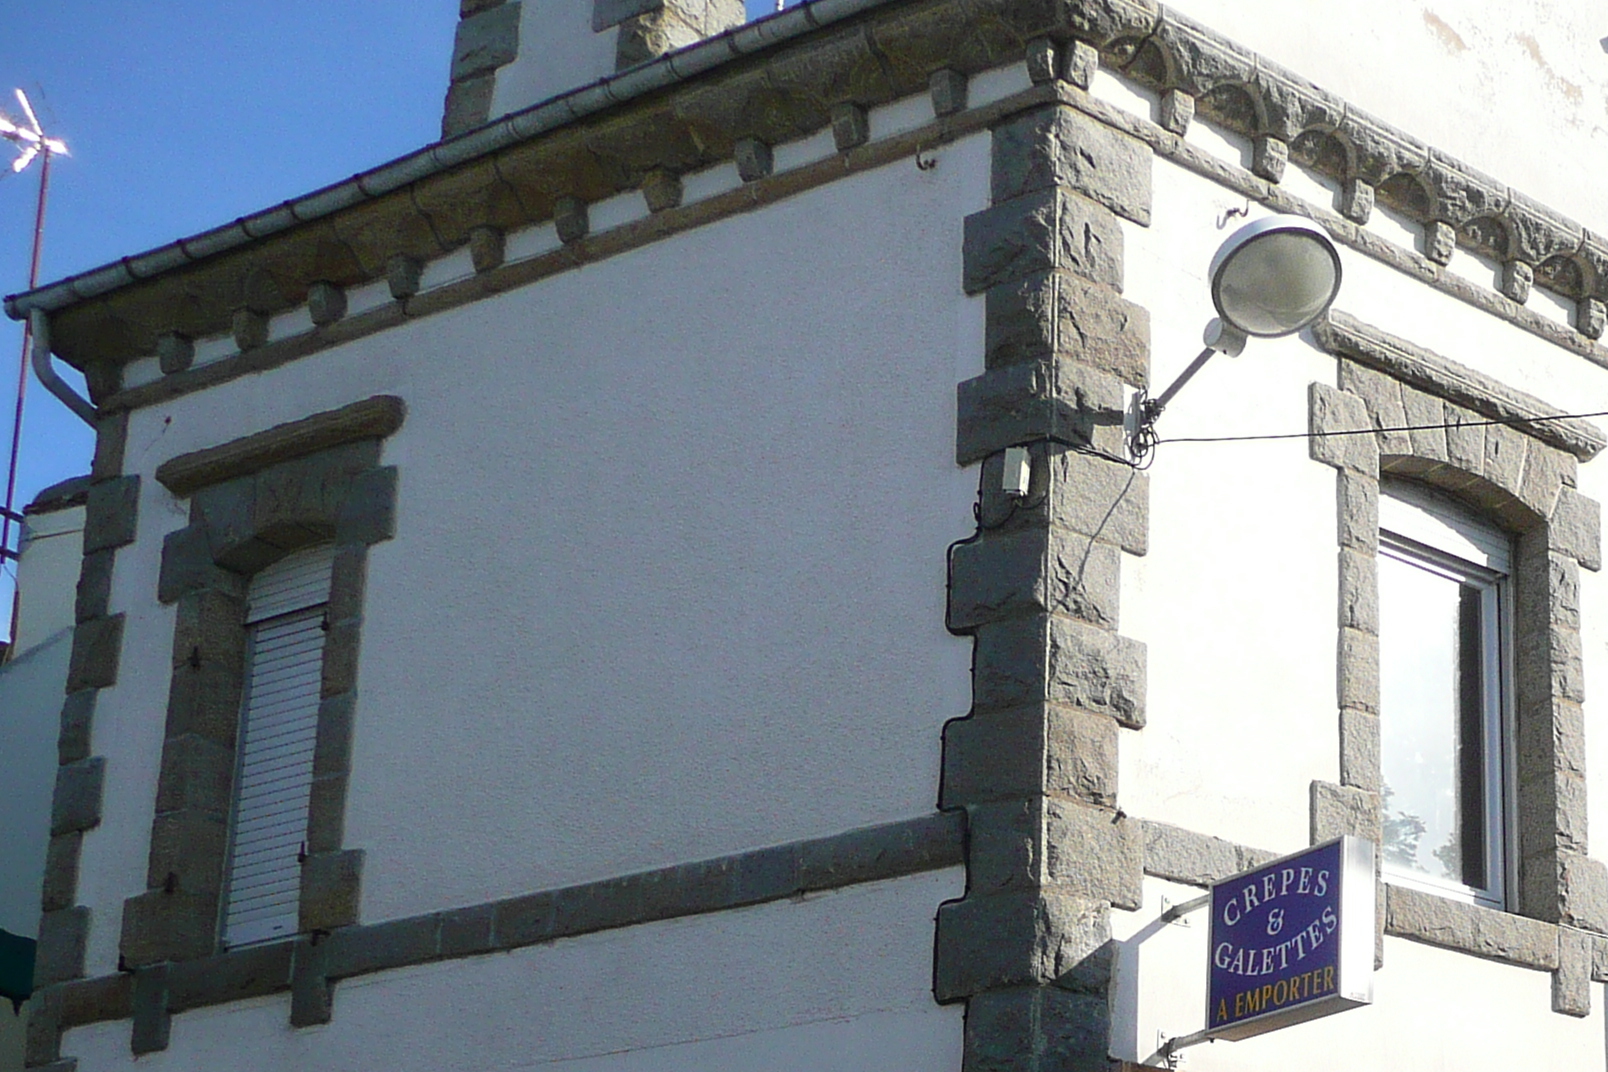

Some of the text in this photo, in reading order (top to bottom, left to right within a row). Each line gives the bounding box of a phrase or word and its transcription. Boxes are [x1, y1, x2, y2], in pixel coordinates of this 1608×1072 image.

[1223, 867, 1329, 926] CREPES
[1266, 908, 1285, 935] &
[1215, 905, 1337, 975] GALETTES
[1216, 966, 1335, 1022] A EMPORTER
